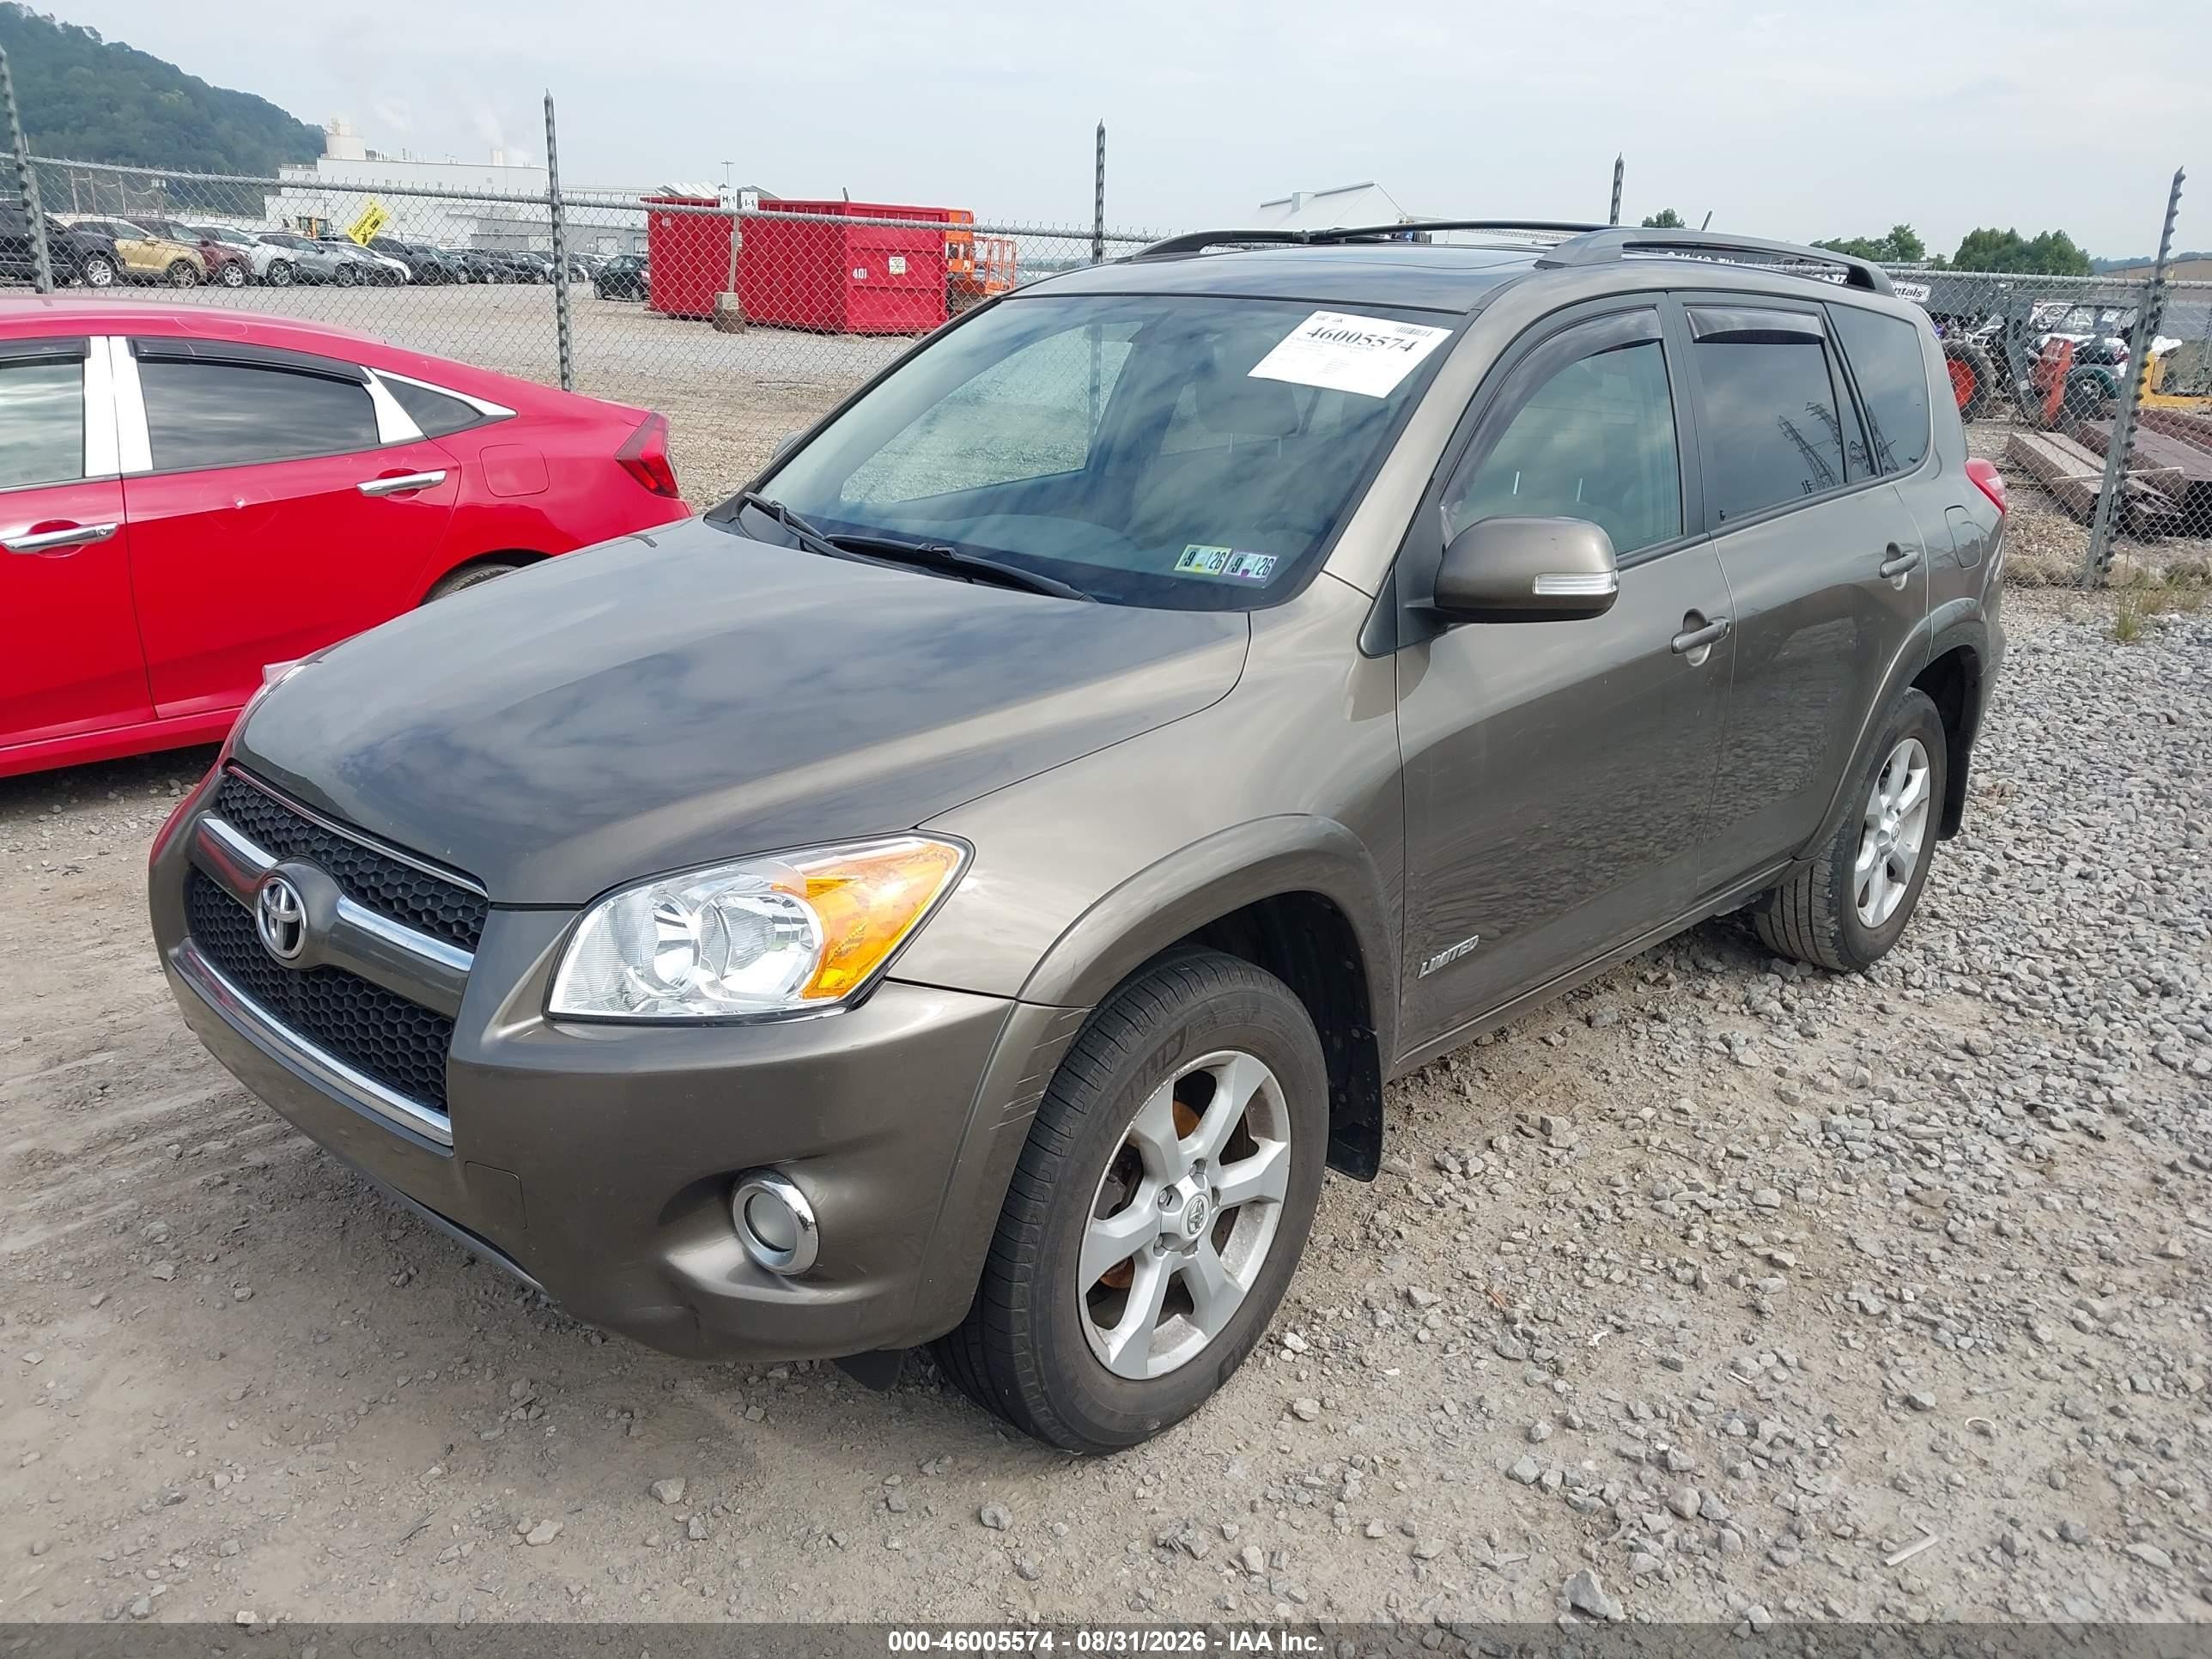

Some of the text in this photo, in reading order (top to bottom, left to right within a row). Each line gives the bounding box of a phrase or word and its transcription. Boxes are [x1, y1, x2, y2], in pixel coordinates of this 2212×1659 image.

[853, 267, 867, 280] 401
[1306, 326, 1418, 352] 46005574
[1417, 934, 1479, 980] LIMITED
